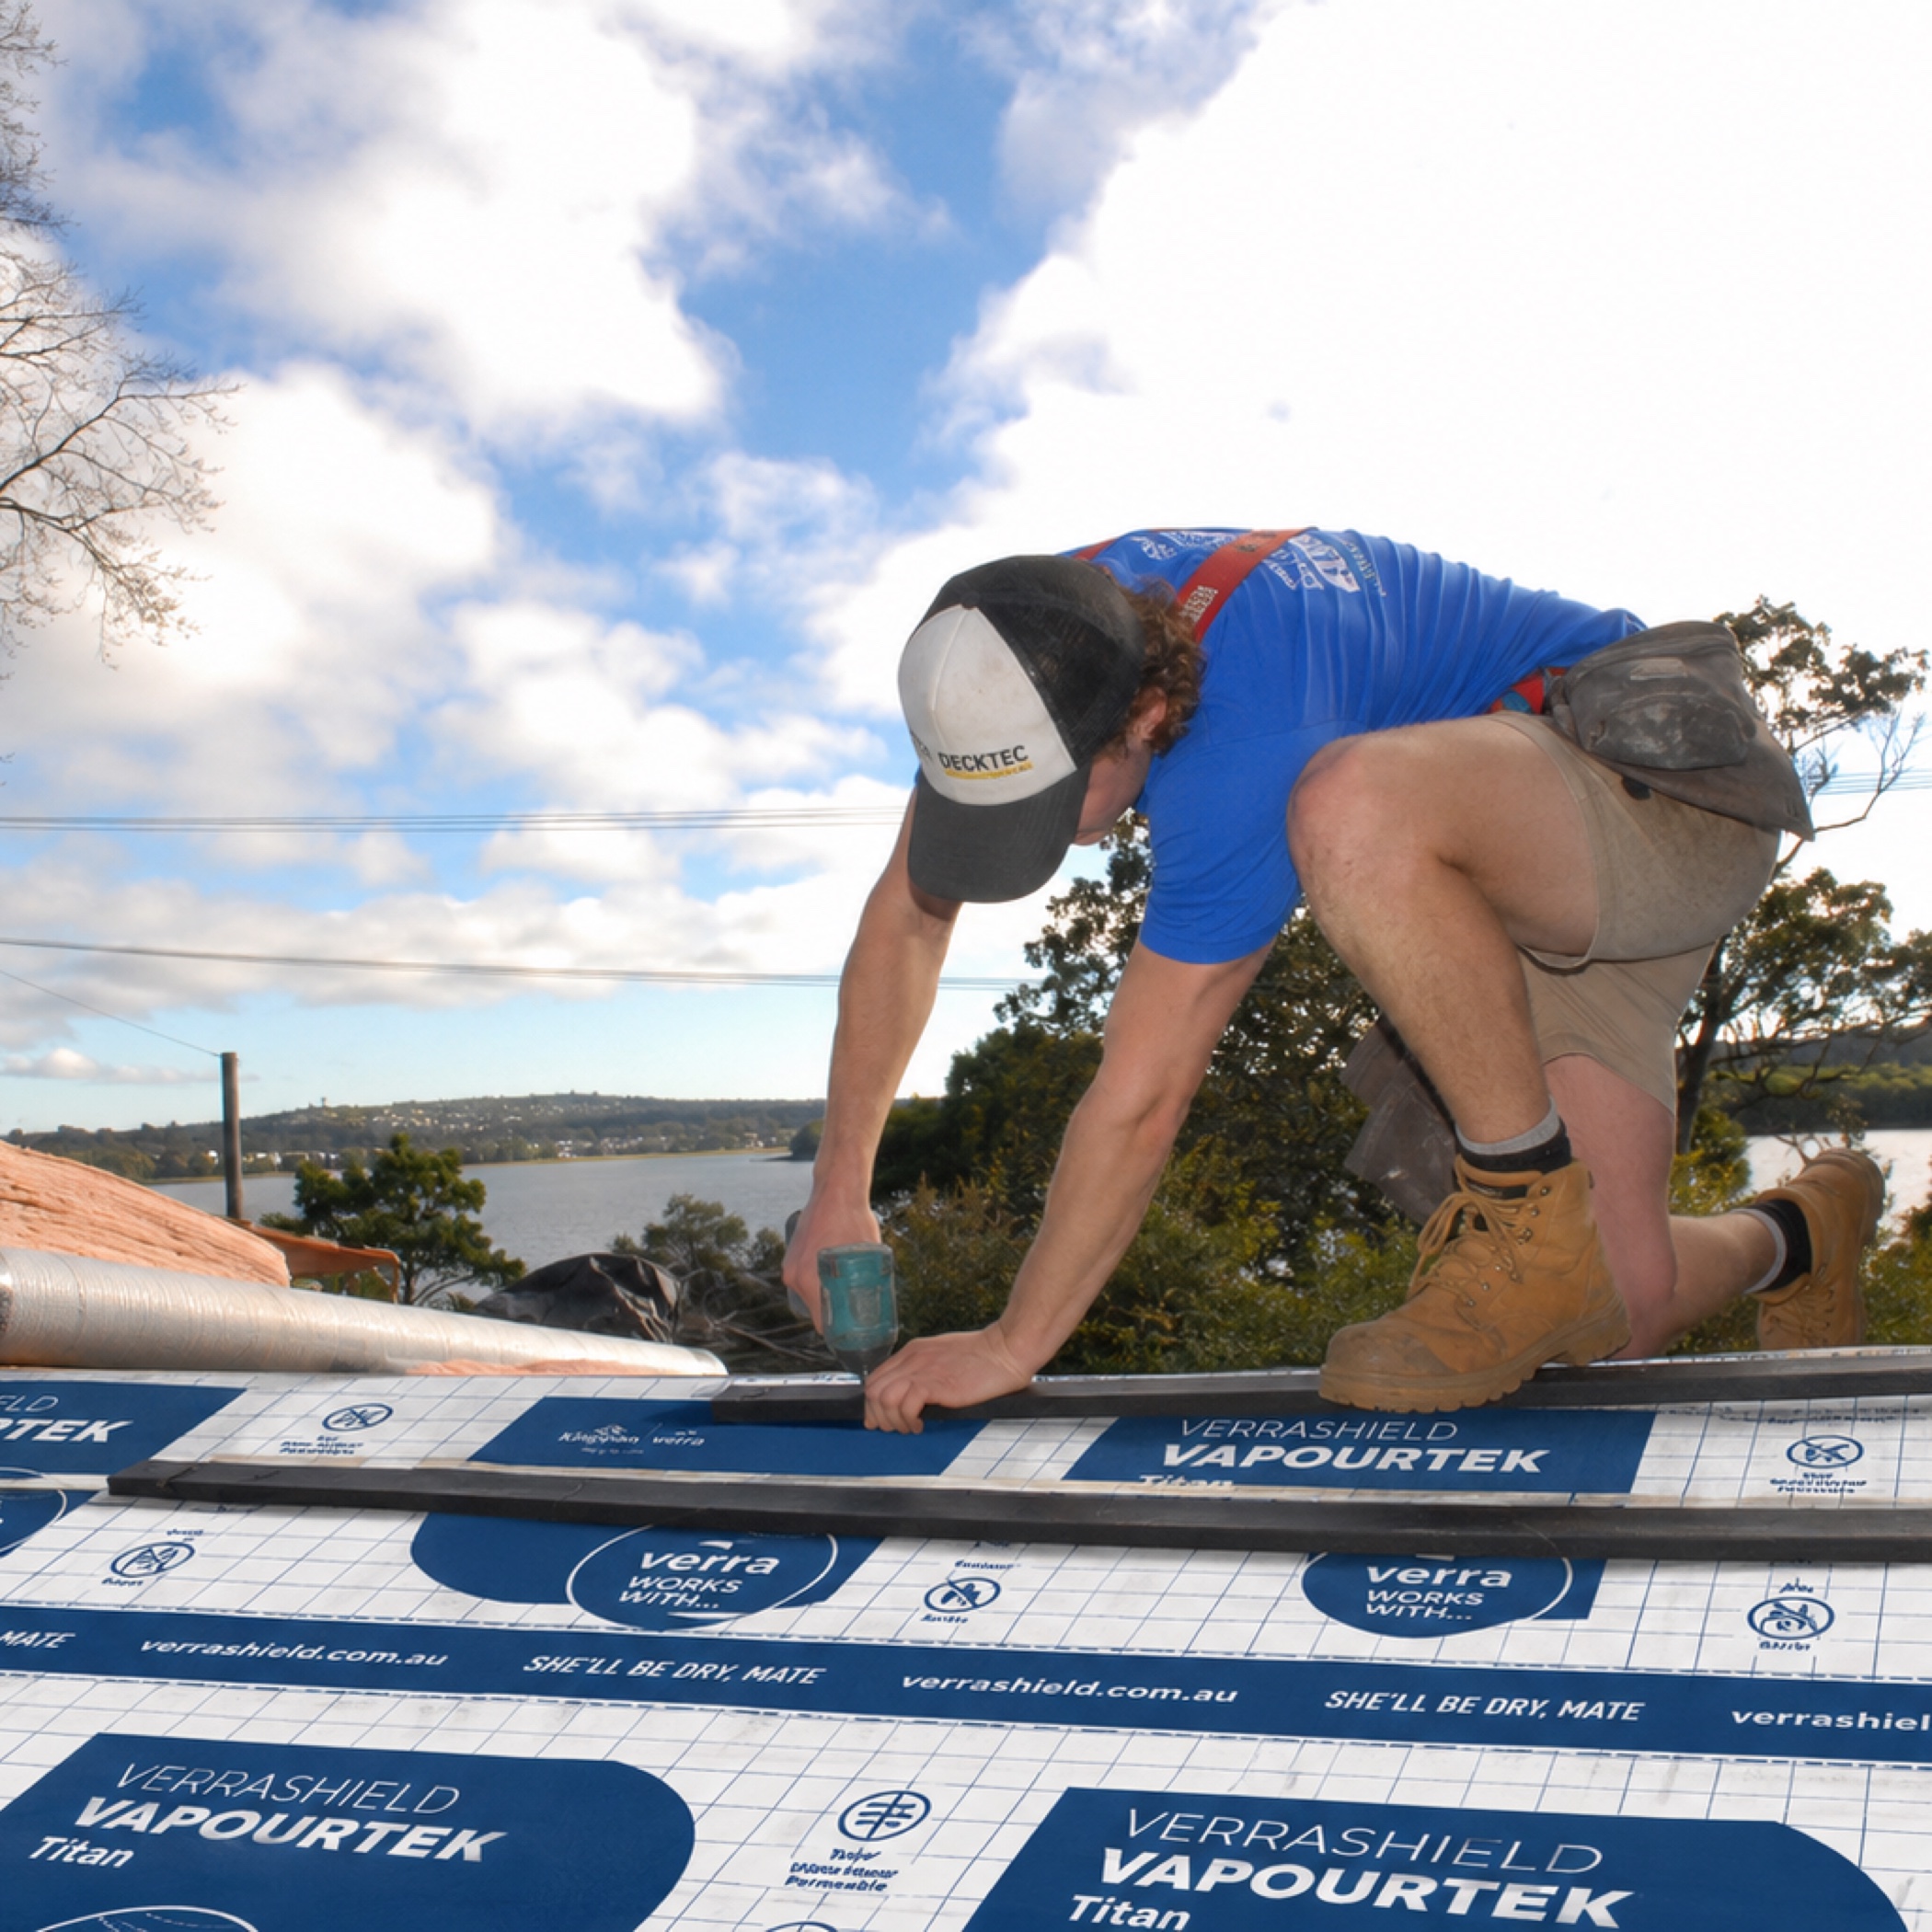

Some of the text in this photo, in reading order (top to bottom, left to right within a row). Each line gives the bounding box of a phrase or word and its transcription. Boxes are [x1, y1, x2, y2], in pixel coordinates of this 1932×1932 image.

[937, 745, 1029, 771] DECKTEC
[1181, 1419, 1459, 1442] VERRASHIELD
[1163, 1443, 1551, 1474] VAPOURTEK
[640, 1552, 780, 1575] verra
[1366, 1566, 1513, 1588] verra
[627, 1575, 743, 1594] WORKS
[1367, 1589, 1486, 1606] WORKS
[618, 1590, 720, 1609] WITH...
[1365, 1603, 1473, 1621] WITH...
[141, 1639, 448, 1667] verrashield.com.au
[522, 1655, 827, 1685] SHE'LL BE DRY, MATE
[902, 1675, 1239, 1704] verrashield.com.au
[1324, 1689, 1646, 1721] SHE'LL BE DRY, MATE
[1731, 1710, 1932, 1731] verrashiel
[115, 1762, 461, 1815] VERRASHIELD
[74, 1796, 508, 1862] VAPOURTEK
[1128, 1807, 1604, 1875] VERRASHIELD
[29, 1834, 135, 1869] Titan
[1101, 1846, 1636, 1929] VAPOURTEK
[1068, 1893, 1191, 1931] Titan
